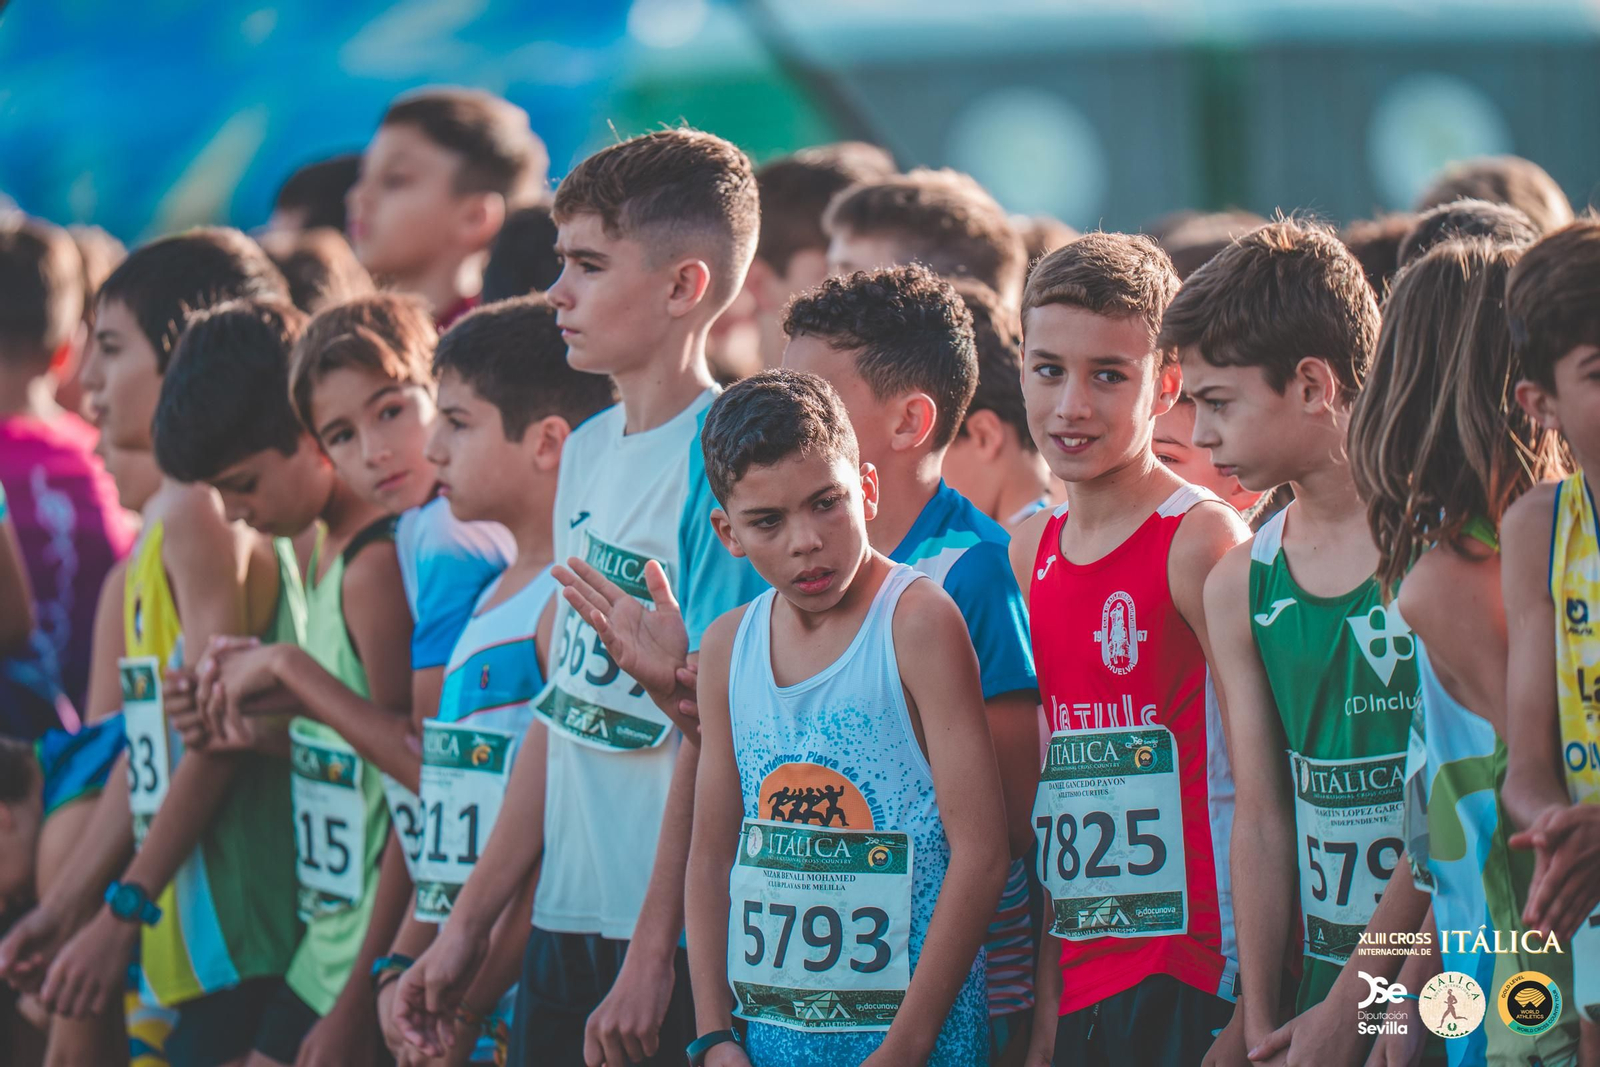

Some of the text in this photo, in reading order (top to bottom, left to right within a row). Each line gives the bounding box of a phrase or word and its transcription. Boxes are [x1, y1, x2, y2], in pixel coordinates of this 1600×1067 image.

[1107, 661, 1136, 676] HUELVA
[1050, 737, 1121, 766] ITÁLICA
[759, 752, 802, 780] Atletismo
[806, 750, 841, 769] Playa
[843, 766, 860, 783] de
[1066, 780, 1096, 789] GANCEDO
[1097, 778, 1126, 787] PAVON
[1082, 788, 1109, 797] CURTIUS
[1342, 807, 1373, 817] LOPEZ
[1330, 815, 1389, 826] INDEPENDIENTE
[768, 830, 852, 858] ITÁLICA
[1036, 808, 1168, 882] 7825
[763, 869, 856, 883] NIZAR BENALI MOHAMED
[802, 883, 810, 891] DE
[1143, 906, 1176, 915] docunova
[743, 900, 892, 974] 5793
[863, 1002, 899, 1010] docunova
